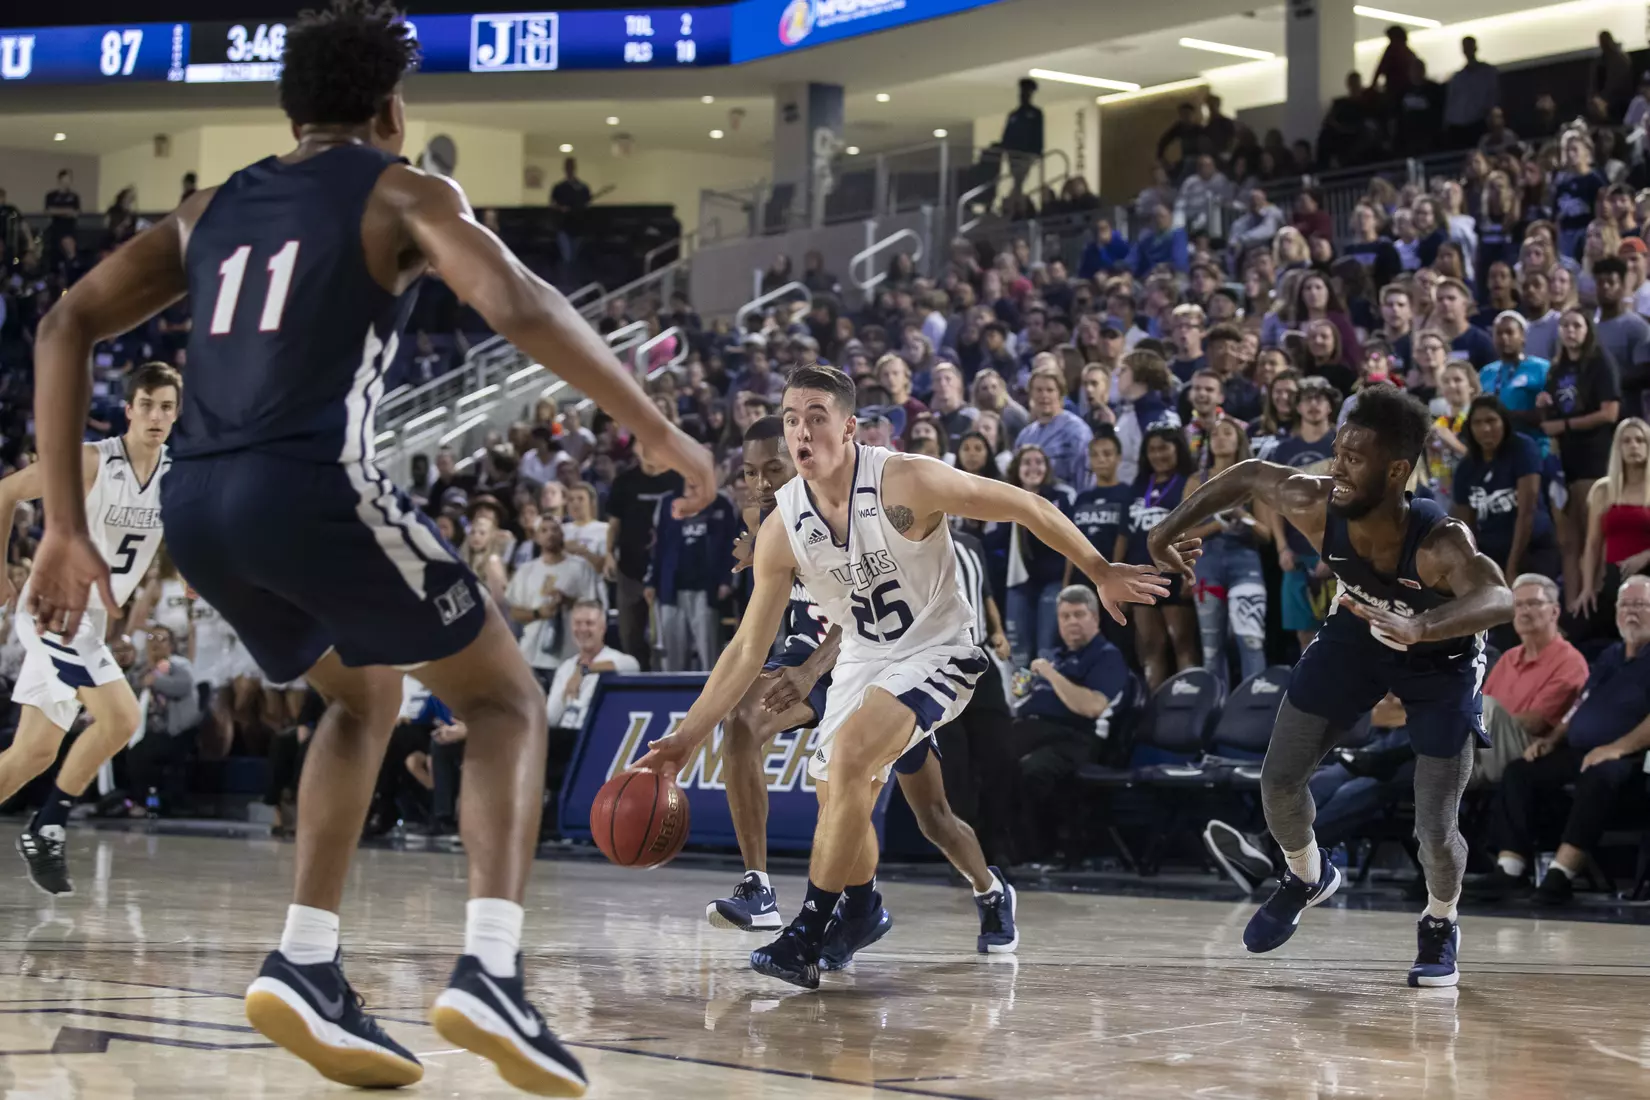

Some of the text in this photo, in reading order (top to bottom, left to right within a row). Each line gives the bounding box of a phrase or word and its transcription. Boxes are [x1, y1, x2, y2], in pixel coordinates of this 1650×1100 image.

[680, 12, 692, 35] 2
[100, 29, 143, 76] 87
[210, 240, 300, 334] 11
[104, 504, 165, 529] LANCER
[857, 506, 877, 518] WAC
[111, 533, 146, 574] 5
[850, 579, 914, 642] 25
